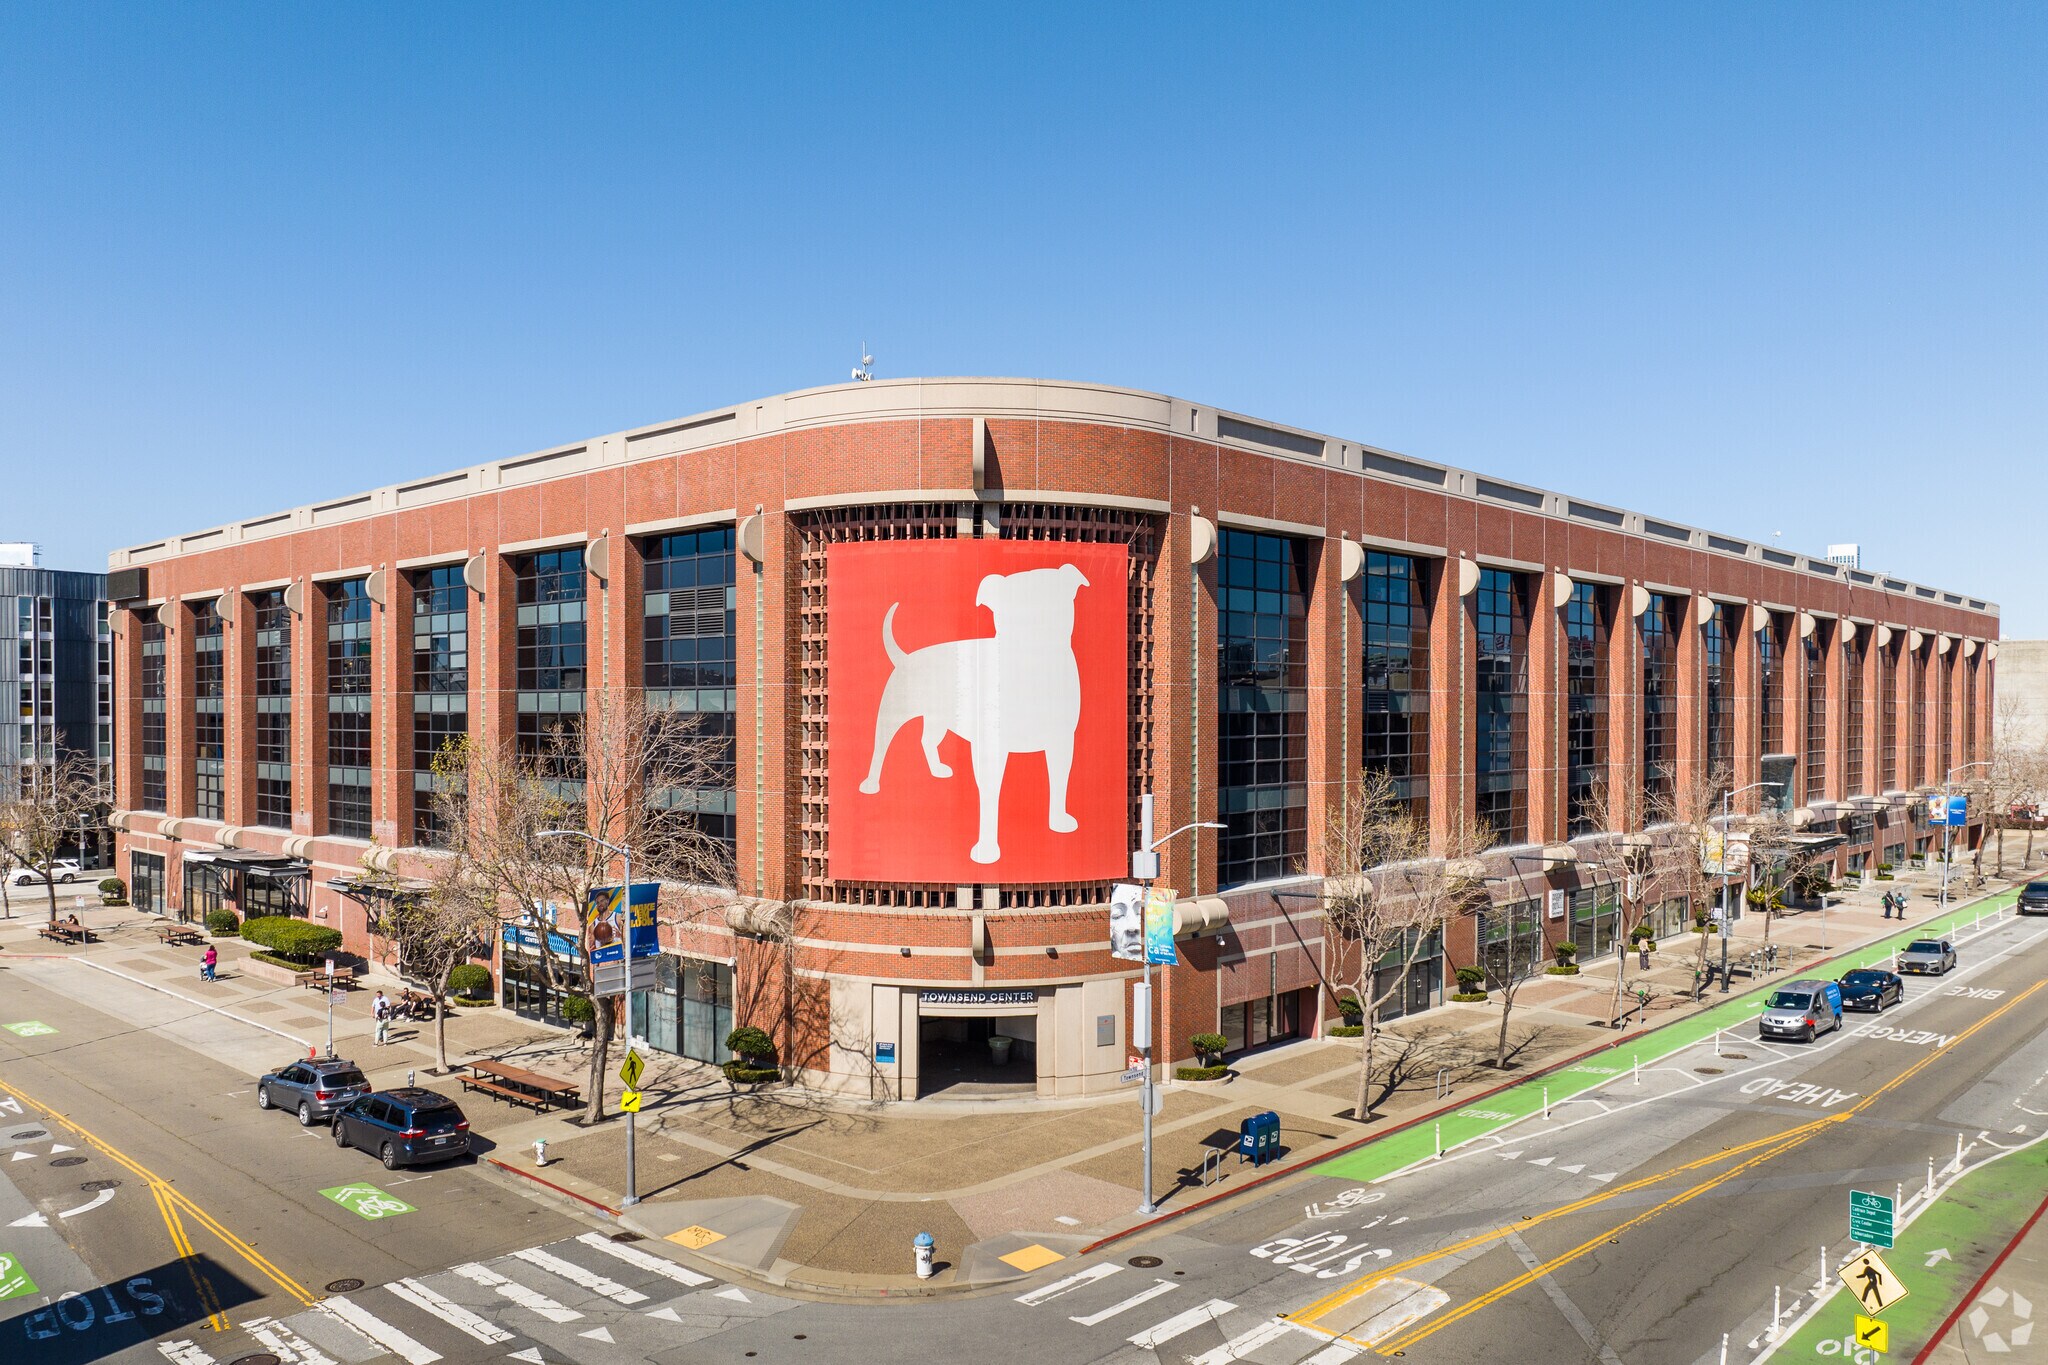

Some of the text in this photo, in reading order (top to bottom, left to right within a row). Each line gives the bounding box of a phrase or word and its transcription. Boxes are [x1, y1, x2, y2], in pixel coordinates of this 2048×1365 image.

[922, 992, 1034, 1002] TOWNSEND CENTER
[1944, 986, 2006, 999] BIKE
[1850, 1025, 1960, 1048] MERGE
[1123, 1071, 1144, 1080] Townsend
[1739, 1077, 1859, 1108] AHEAD
[1457, 1109, 1517, 1121] AHEAD
[1249, 1230, 1392, 1279] STOP
[24, 1277, 165, 1340] STOP
